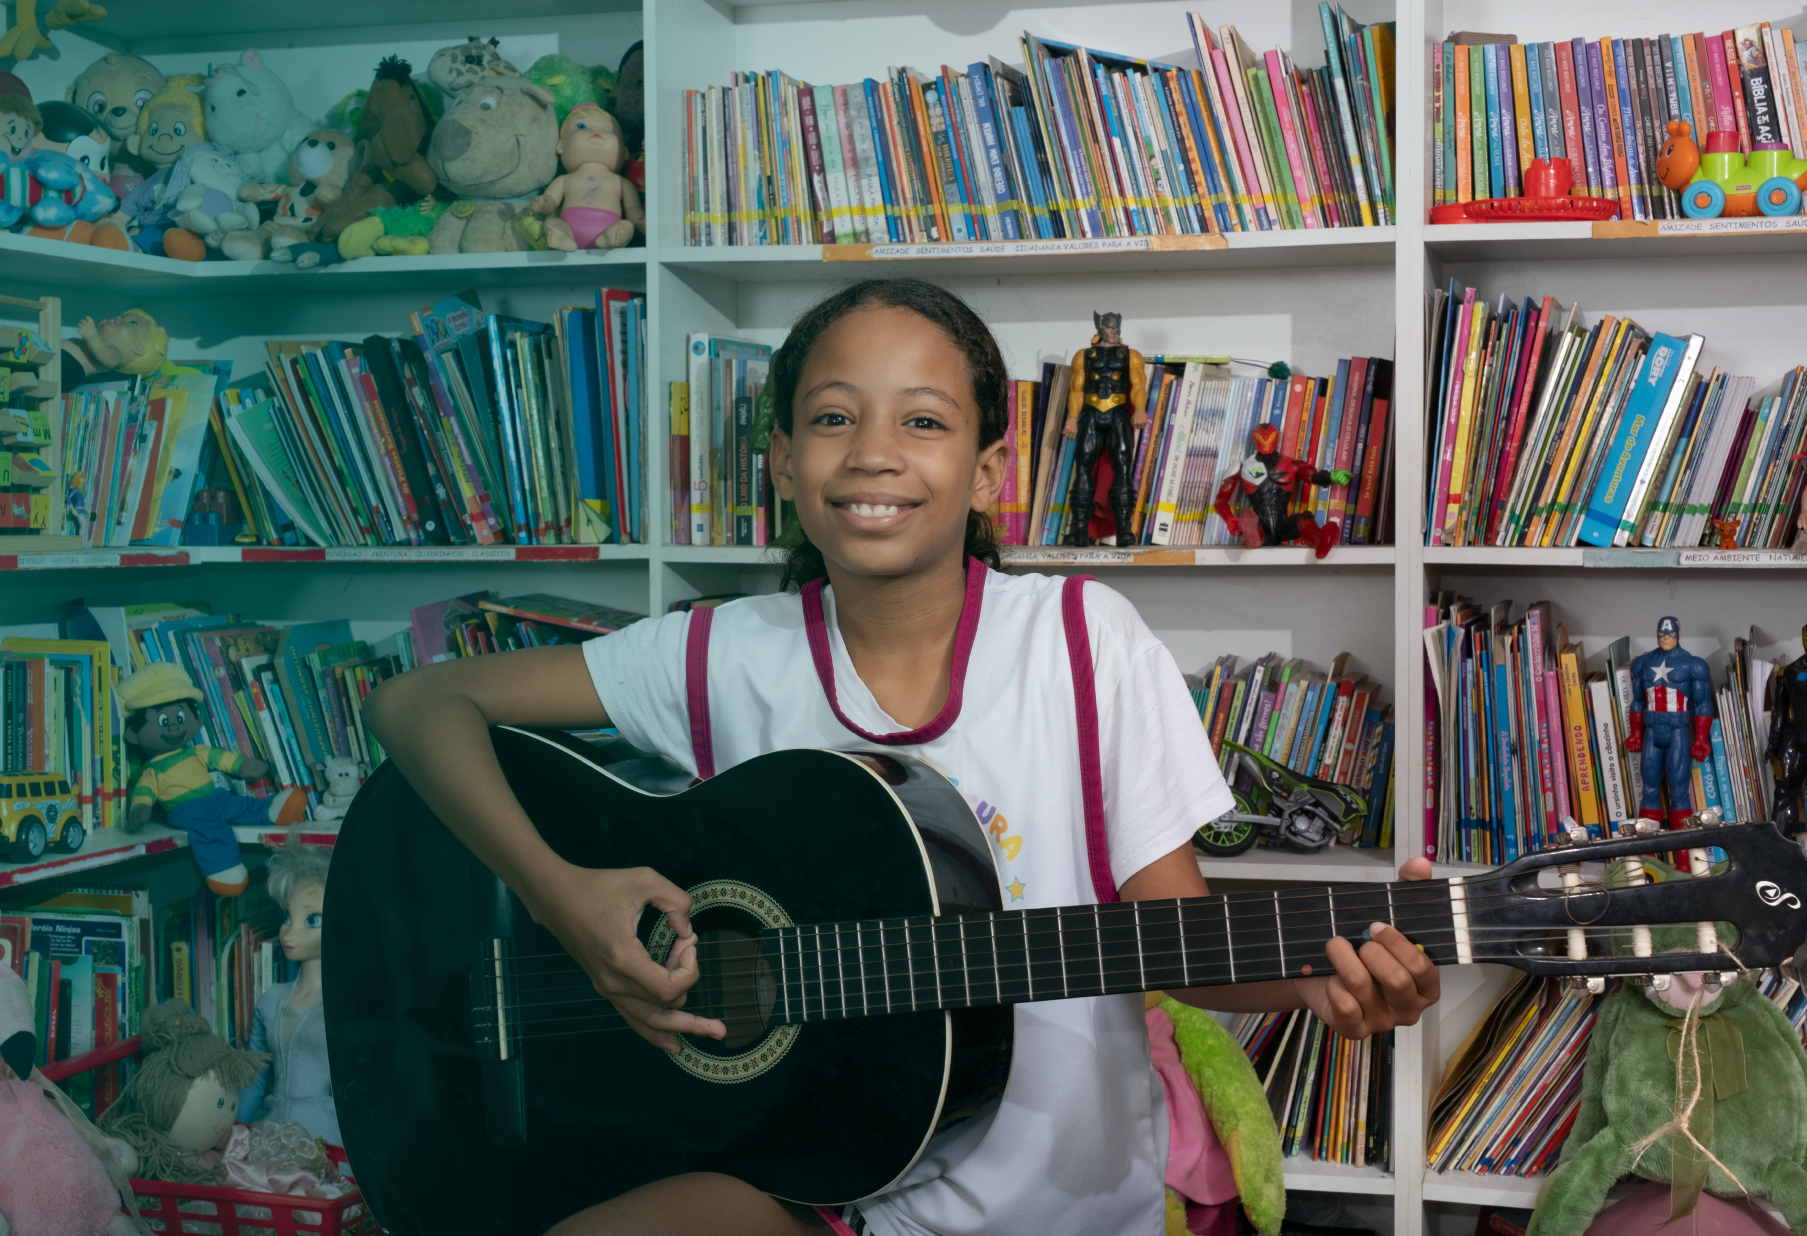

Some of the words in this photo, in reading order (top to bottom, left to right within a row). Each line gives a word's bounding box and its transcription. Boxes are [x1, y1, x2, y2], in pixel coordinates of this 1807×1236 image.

[1322, 13, 1331, 37] Achados
[1328, 44, 1337, 69] Perdidos
[1726, 39, 1735, 65] NEAGLE
[1688, 53, 1696, 84] CHRISTIAN
[1787, 49, 1797, 80] CHRISTIAN
[1239, 96, 1248, 108] João
[1597, 104, 1605, 114] Os
[1751, 77, 1768, 115] BÍBLIA
[1170, 106, 1181, 138] DOMINGUES
[1337, 90, 1345, 107] Oliver
[1341, 110, 1350, 132] Jeffers
[1502, 110, 1512, 138] Anne
[1548, 109, 1559, 138] Anne
[1581, 107, 1592, 135] Anne
[1623, 107, 1631, 126] Mais
[1721, 105, 1732, 125] Rilla
[1757, 115, 1769, 124] EM
[983, 122, 995, 146] HANSEN
[1458, 113, 1467, 141] Anne
[1474, 113, 1484, 141] Anne
[1490, 113, 1499, 141] Anne
[1534, 110, 1544, 139] Anne
[1565, 110, 1575, 139] Anne
[1599, 117, 1609, 141] Contos
[1626, 129, 1634, 156] crônicas
[989, 149, 998, 165] EVAN
[993, 167, 1005, 194] QUERIDO
[1603, 159, 1614, 185] Blythes
[1660, 222, 1702, 231] AMIZADE
[1710, 220, 1777, 230] SENTIMENTOS
[915, 246, 973, 254] SENTIMENTOS
[980, 243, 1006, 253] SAÚDE
[1015, 244, 1061, 252] CIDADANIA
[1063, 241, 1099, 250] VALORES
[1648, 346, 1668, 387] DORY
[1351, 372, 1360, 396] MENINA,
[373, 399, 394, 450] Barulhentos
[1346, 399, 1355, 425] DESLIGA
[1632, 414, 1645, 434] Mar
[739, 434, 749, 469] HISTÓRIA
[1341, 432, 1351, 461] CELULAR!
[1625, 434, 1637, 452] de
[391, 451, 403, 479] Piratas
[741, 471, 748, 482] DA
[1169, 463, 1179, 478] JACARÉ
[1368, 460, 1376, 474] Está
[1604, 450, 1632, 504] Aventuras
[402, 480, 409, 494] Os
[694, 479, 708, 492] 5
[1165, 485, 1175, 503] FAMÍLIA
[1364, 491, 1370, 499] Se
[1366, 476, 1374, 490] Você
[19, 557, 45, 565] DIVERSÃO
[327, 550, 363, 558] DIVERSÃO
[415, 550, 463, 558] QUADRINHOS
[471, 549, 511, 557] CLÁSSICOS
[1662, 619, 1672, 631] A
[1534, 634, 1542, 674] Cachorrinho
[290, 646, 309, 694] VERMELHO
[1620, 676, 1629, 704] QUATRO
[1261, 700, 1273, 729] germes?
[1366, 720, 1376, 739] Jesus
[1603, 722, 1614, 754] cãozinho
[1362, 740, 1372, 756] para
[1573, 725, 1591, 792] APRENDENDO
[1355, 757, 1367, 787] crianças
[1607, 764, 1616, 782] visita
[1716, 756, 1726, 776] Peppa
[1611, 783, 1621, 810] ursinho
[1706, 774, 1716, 798] COCÔ
[1721, 784, 1729, 792] os
[1723, 794, 1732, 809] ovos
[1726, 811, 1734, 819] de
[55, 924, 81, 933] Ninjas
[174, 957, 183, 989] FORMAS
[50, 1009, 58, 1038] NATAL
